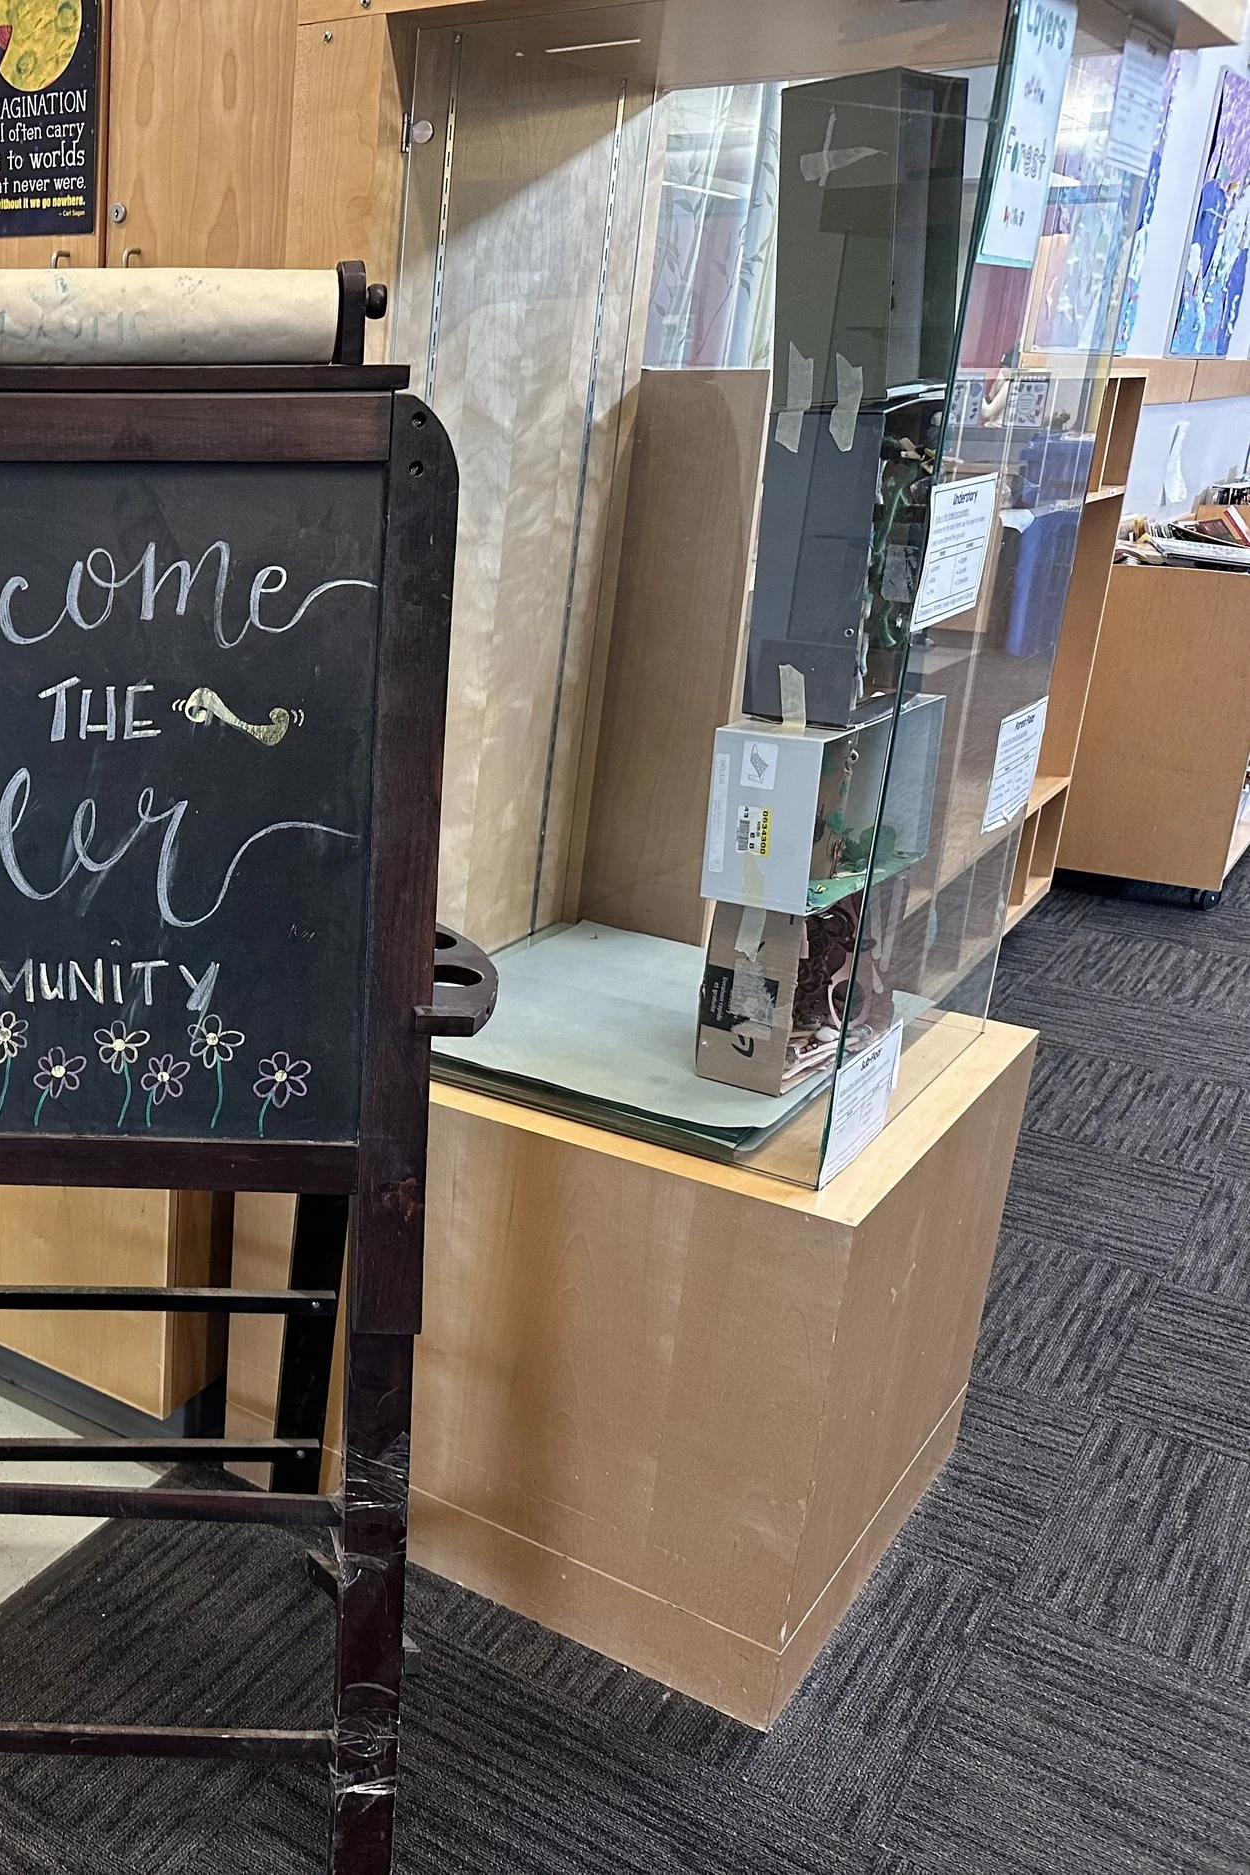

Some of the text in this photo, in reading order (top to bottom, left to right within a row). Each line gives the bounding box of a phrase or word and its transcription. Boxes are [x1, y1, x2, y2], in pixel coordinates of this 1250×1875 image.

[8, 122, 42, 142] often
[45, 122, 86, 144] carry
[6, 149, 24, 171] to
[28, 140, 85, 170] worlds
[12, 178, 51, 193] never
[53, 176, 87, 191] were.
[29, 198, 41, 209] we
[41, 197, 51, 210] go
[52, 195, 86, 208] nowhere.
[38, 675, 162, 743] THE
